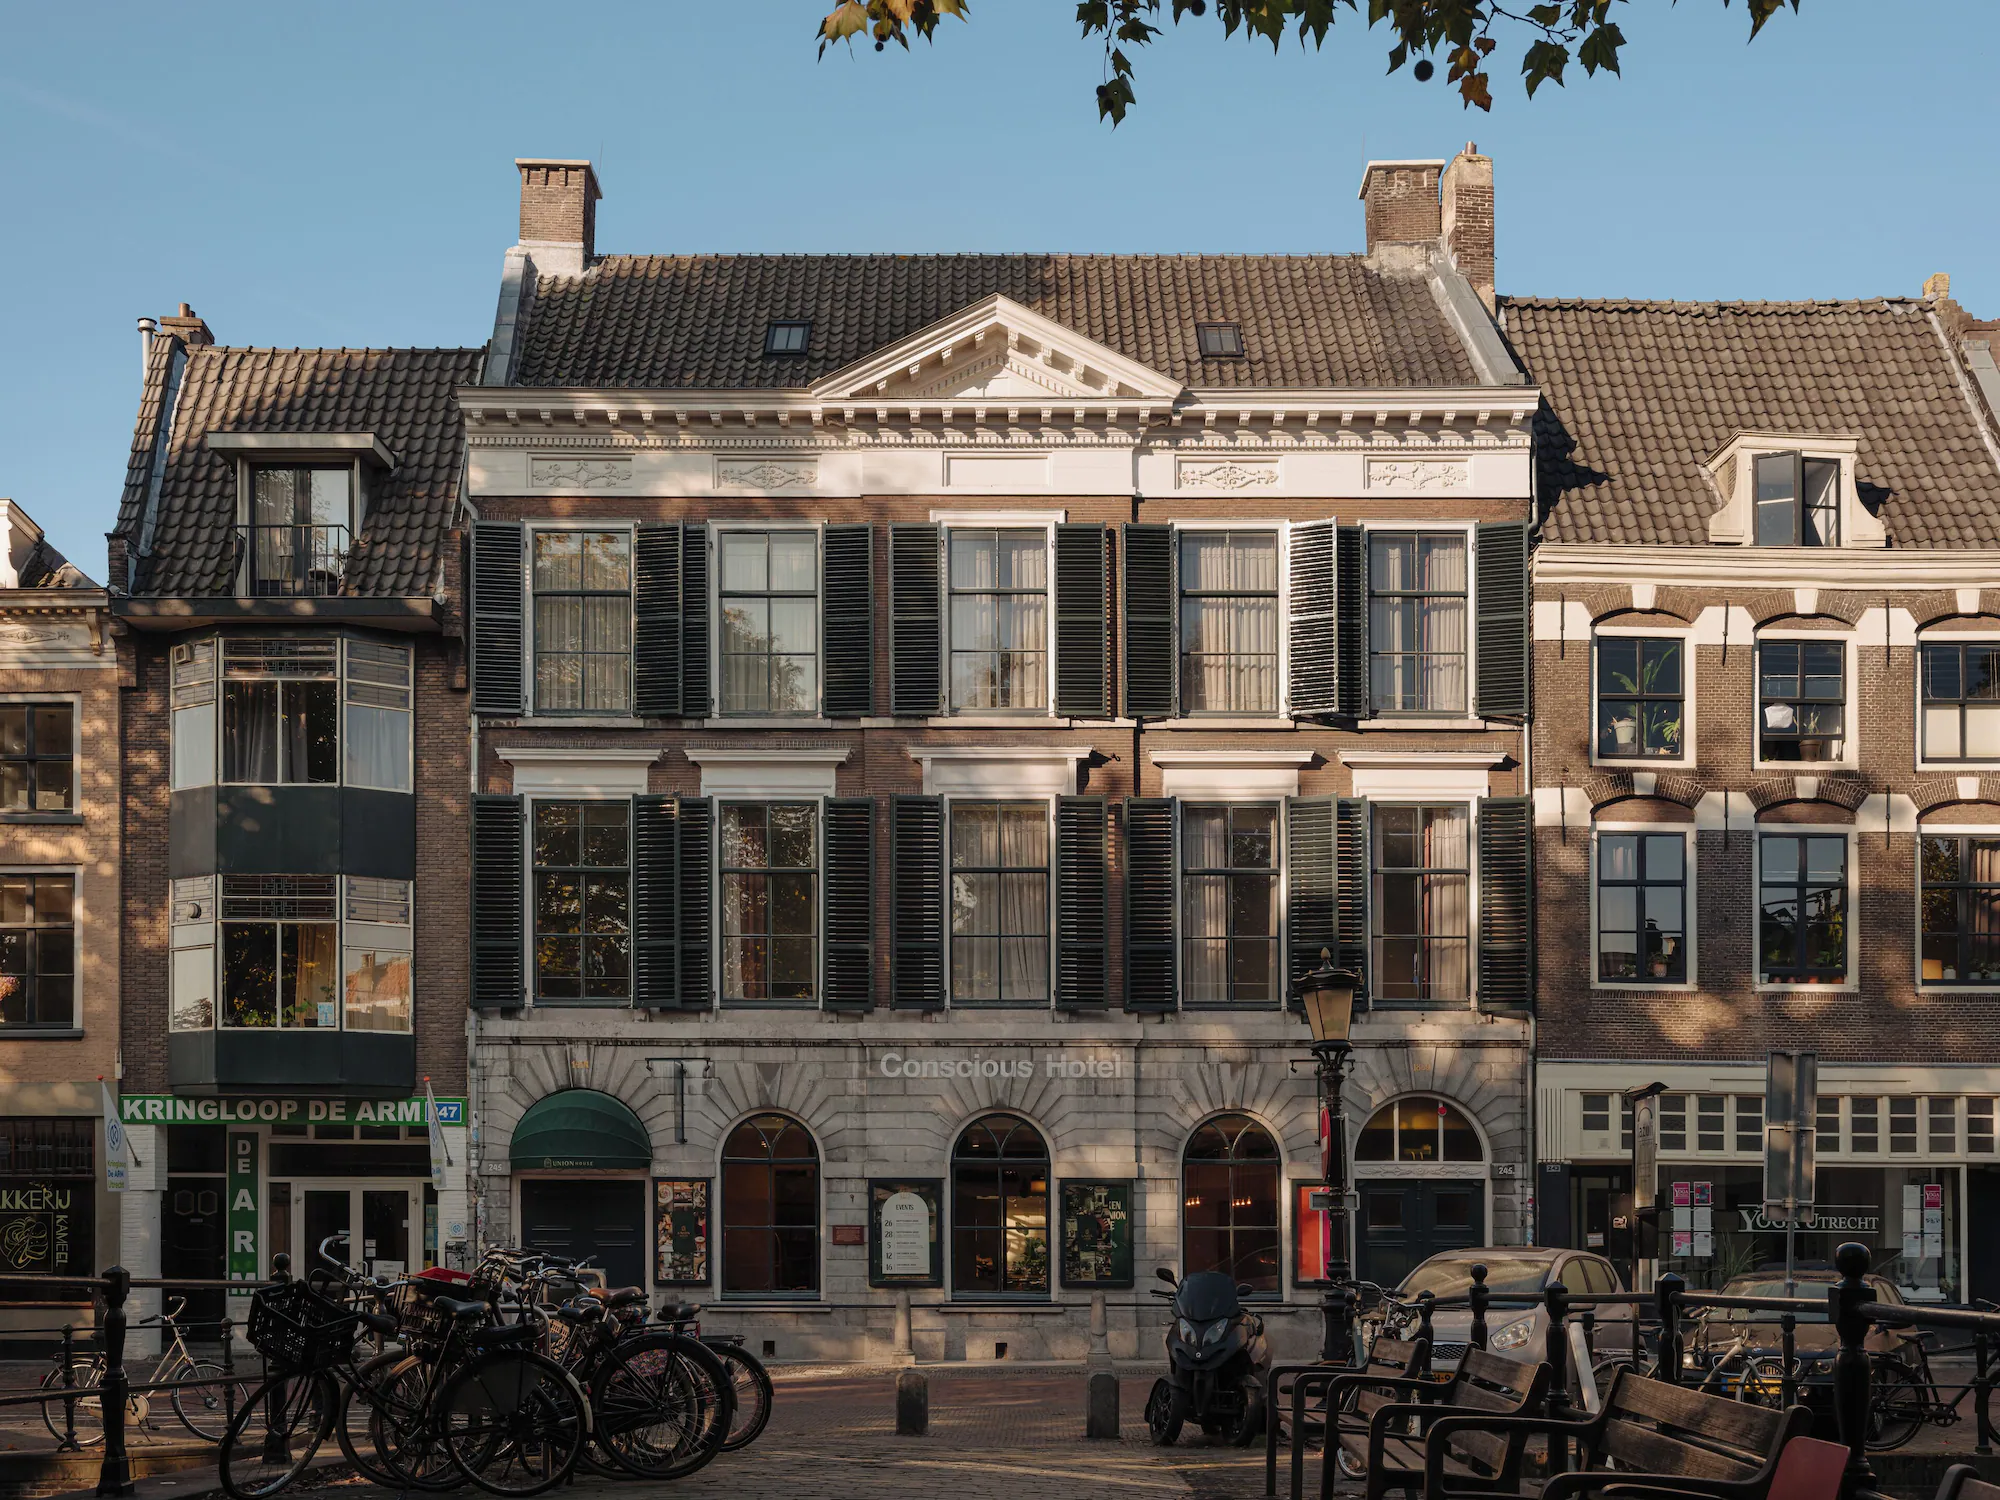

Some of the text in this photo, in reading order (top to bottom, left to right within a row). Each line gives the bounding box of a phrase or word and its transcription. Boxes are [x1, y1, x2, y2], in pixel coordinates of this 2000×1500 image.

[880, 1053, 1121, 1078] Conscious Hotel
[122, 1099, 421, 1122] KRINGLOOP DE ARM
[435, 1106, 459, 1119] 47
[237, 1139, 252, 1174] DE
[488, 1163, 503, 1171] 245
[0, 1189, 71, 1210] KKERIJ
[1805, 1213, 1879, 1229] UTRECHT
[56, 1214, 70, 1268] KAMEEL
[231, 1188, 256, 1295] ARM
